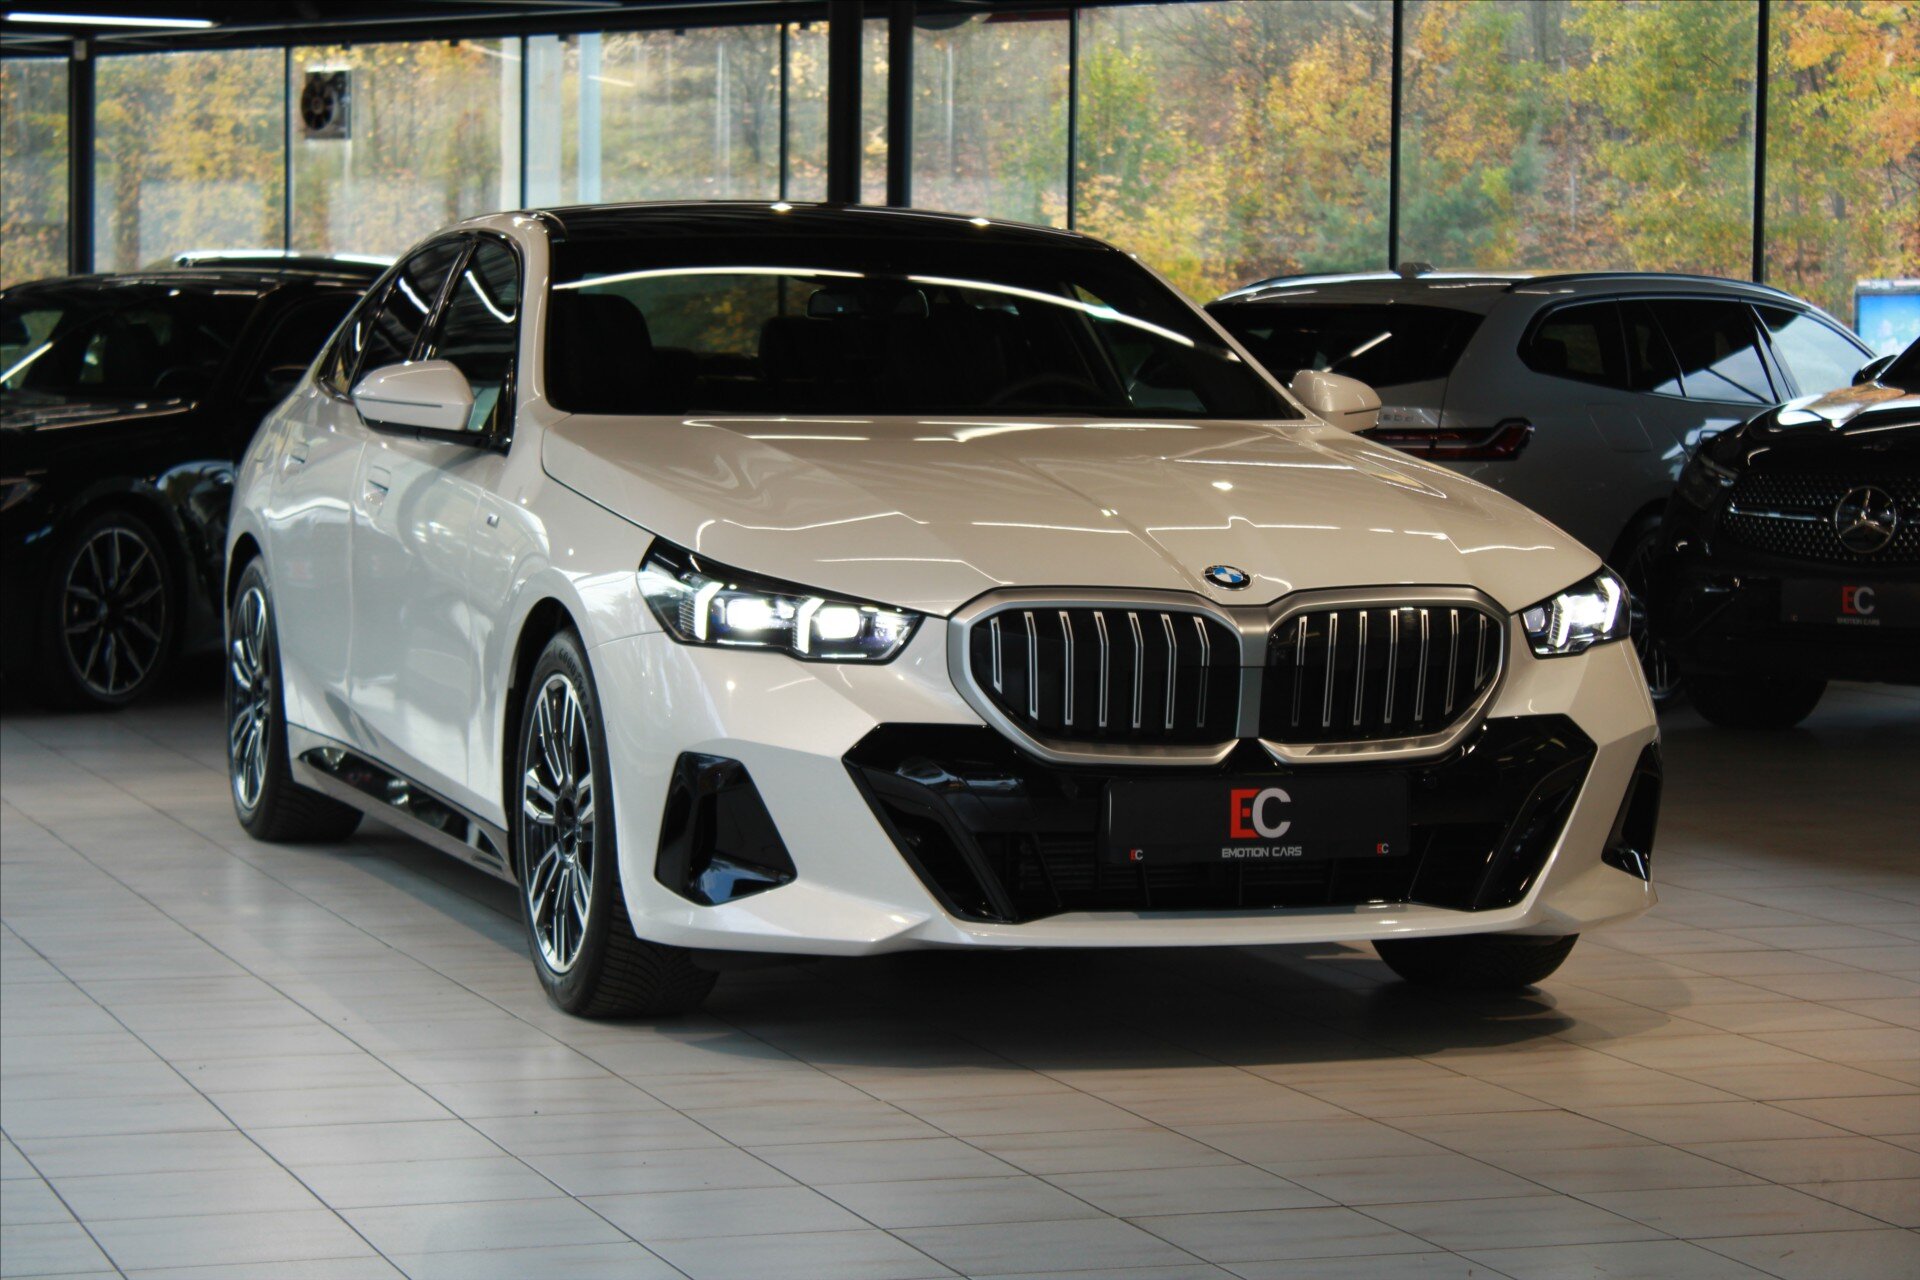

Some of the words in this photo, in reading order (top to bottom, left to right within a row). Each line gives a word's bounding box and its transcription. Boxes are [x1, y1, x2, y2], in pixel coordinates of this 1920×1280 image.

[1841, 585, 1875, 615] EC
[1229, 787, 1292, 839] EC
[1221, 847, 1269, 859] EMOTION
[1271, 846, 1302, 857] CARS
[1376, 842, 1389, 854] EC
[1129, 849, 1144, 861] EC
